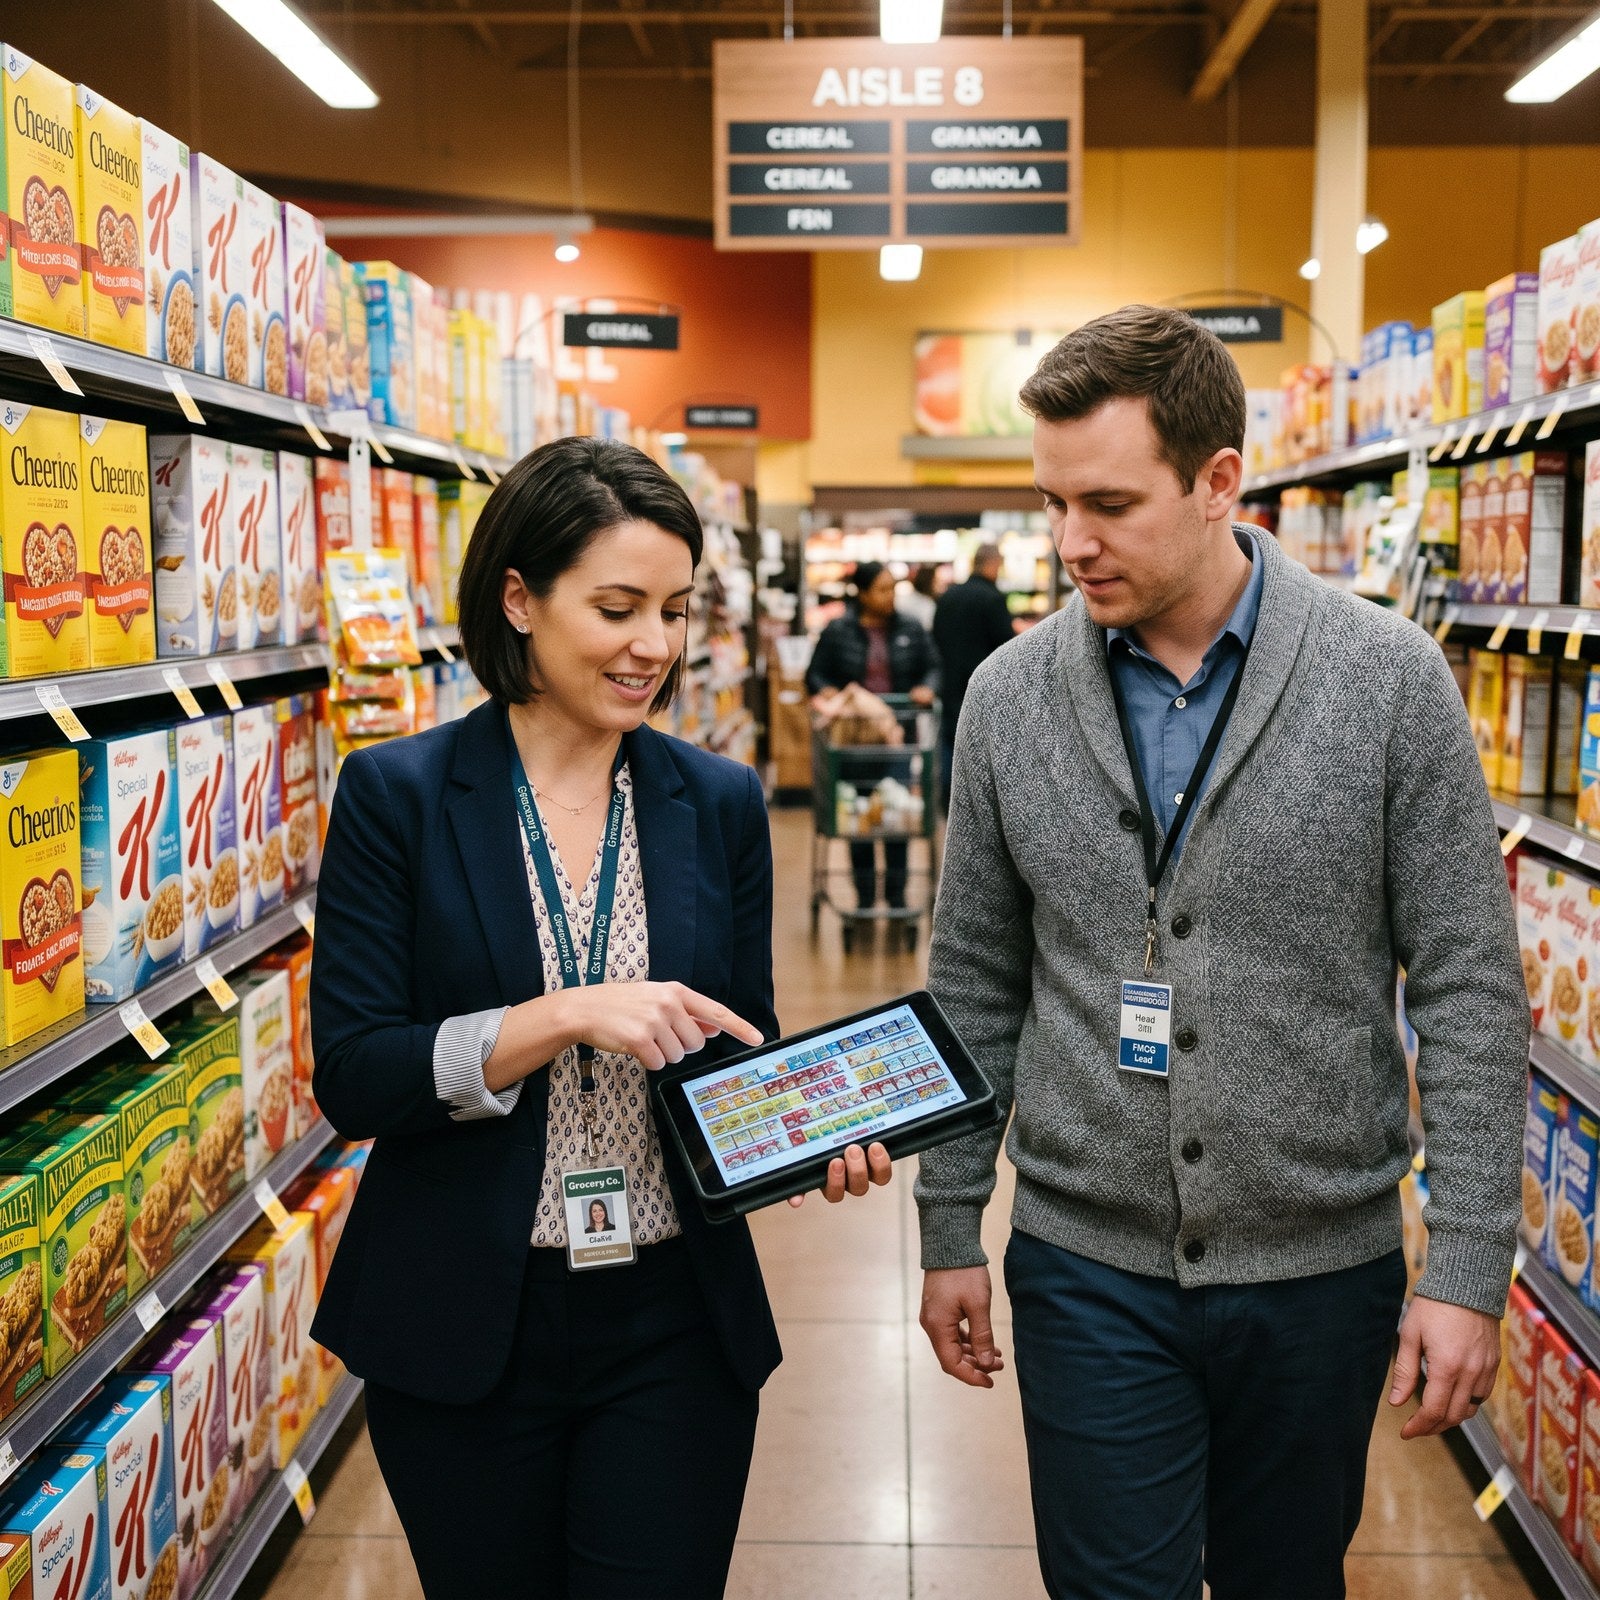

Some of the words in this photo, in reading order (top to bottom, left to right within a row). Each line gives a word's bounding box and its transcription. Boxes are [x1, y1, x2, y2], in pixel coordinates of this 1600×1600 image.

[812, 66, 944, 107] AISLE
[953, 66, 984, 106] 8
[14, 94, 74, 160] Cheerios
[766, 127, 854, 149] CEREAL
[931, 125, 1042, 148] GRANOLA
[90, 131, 139, 189] Cheerios
[764, 168, 853, 190] CEREAL
[930, 166, 1042, 189] GRANOLA
[148, 172, 181, 270] K
[208, 202, 237, 294] K
[586, 321, 653, 342] CEREAL
[11, 445, 78, 491] Cheerios
[90, 456, 146, 498] Cheerios
[201, 472, 229, 572] K
[239, 479, 268, 574] K
[117, 773, 148, 801] Special
[242, 739, 272, 845] K
[9, 801, 76, 849] Cheerios
[118, 769, 165, 901] K
[186, 753, 223, 870] K
[1135, 1013, 1156, 1024] Head
[1132, 1043, 1156, 1054] FMCG
[1134, 1053, 1153, 1064] Lead
[127, 1095, 160, 1144] NATURE
[49, 1150, 87, 1209] NATURE
[86, 1124, 118, 1167] VALLEY
[568, 1179, 605, 1191] Grocery
[606, 1177, 621, 1186] Co.
[181, 1363, 214, 1499] K
[114, 1444, 144, 1489] Special
[115, 1432, 159, 1587] K
[41, 1527, 75, 1579] Special
